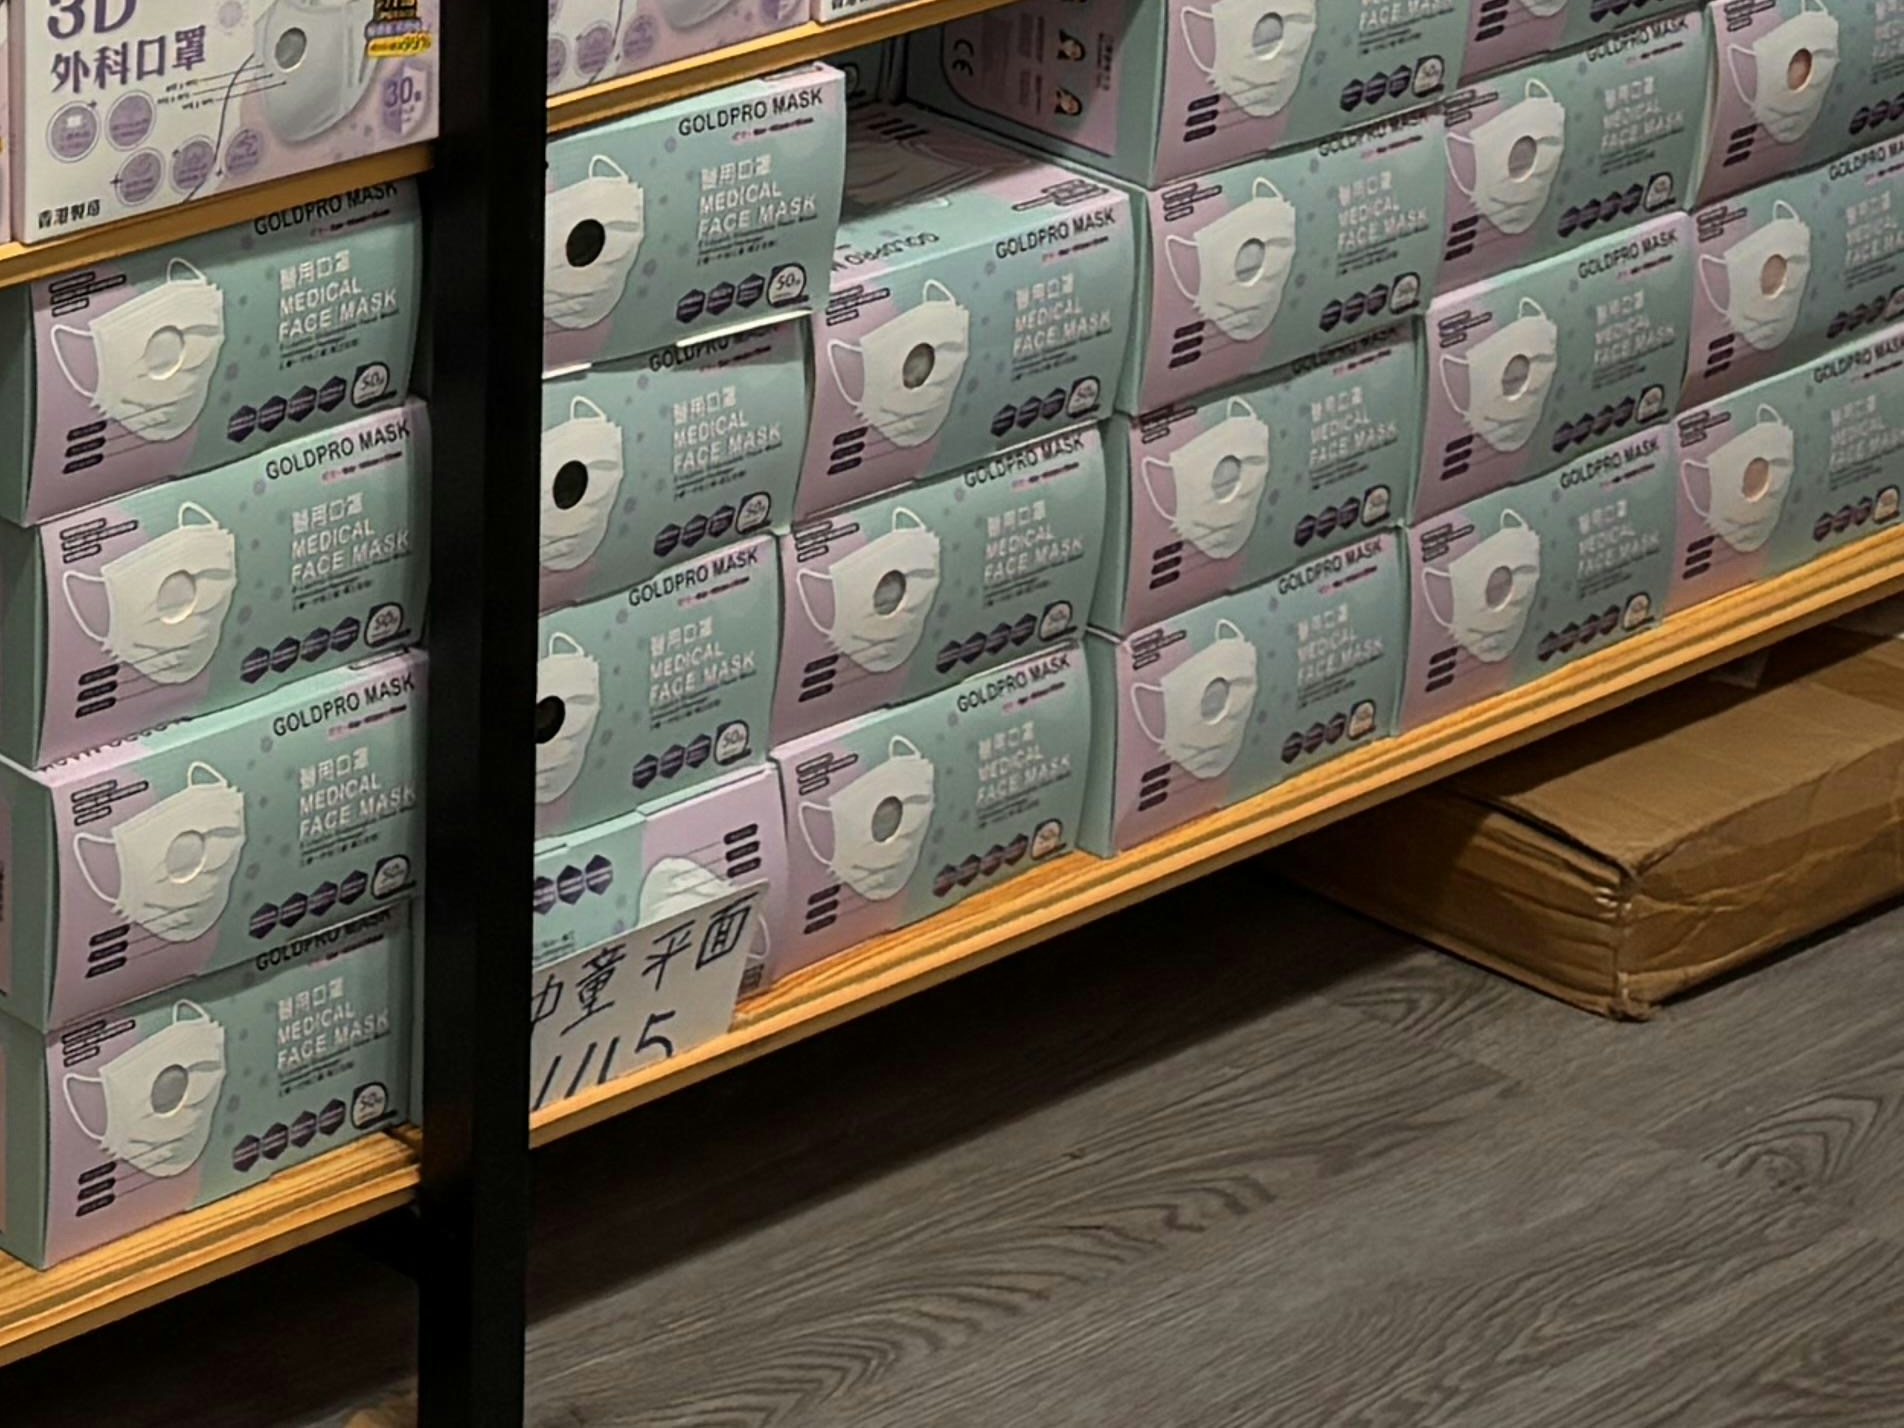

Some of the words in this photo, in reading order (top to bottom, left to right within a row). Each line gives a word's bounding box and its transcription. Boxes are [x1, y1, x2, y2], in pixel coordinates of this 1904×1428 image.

[677, 99, 769, 137] GOLDPRO
[771, 87, 824, 118] MASK
[700, 181, 784, 214] MEDICAL
[264, 436, 356, 482] GOLDPRO
[357, 420, 412, 451] MASK
[291, 519, 376, 559] MEDICAL
[291, 555, 349, 584] FACE
[352, 528, 411, 570] MASK
